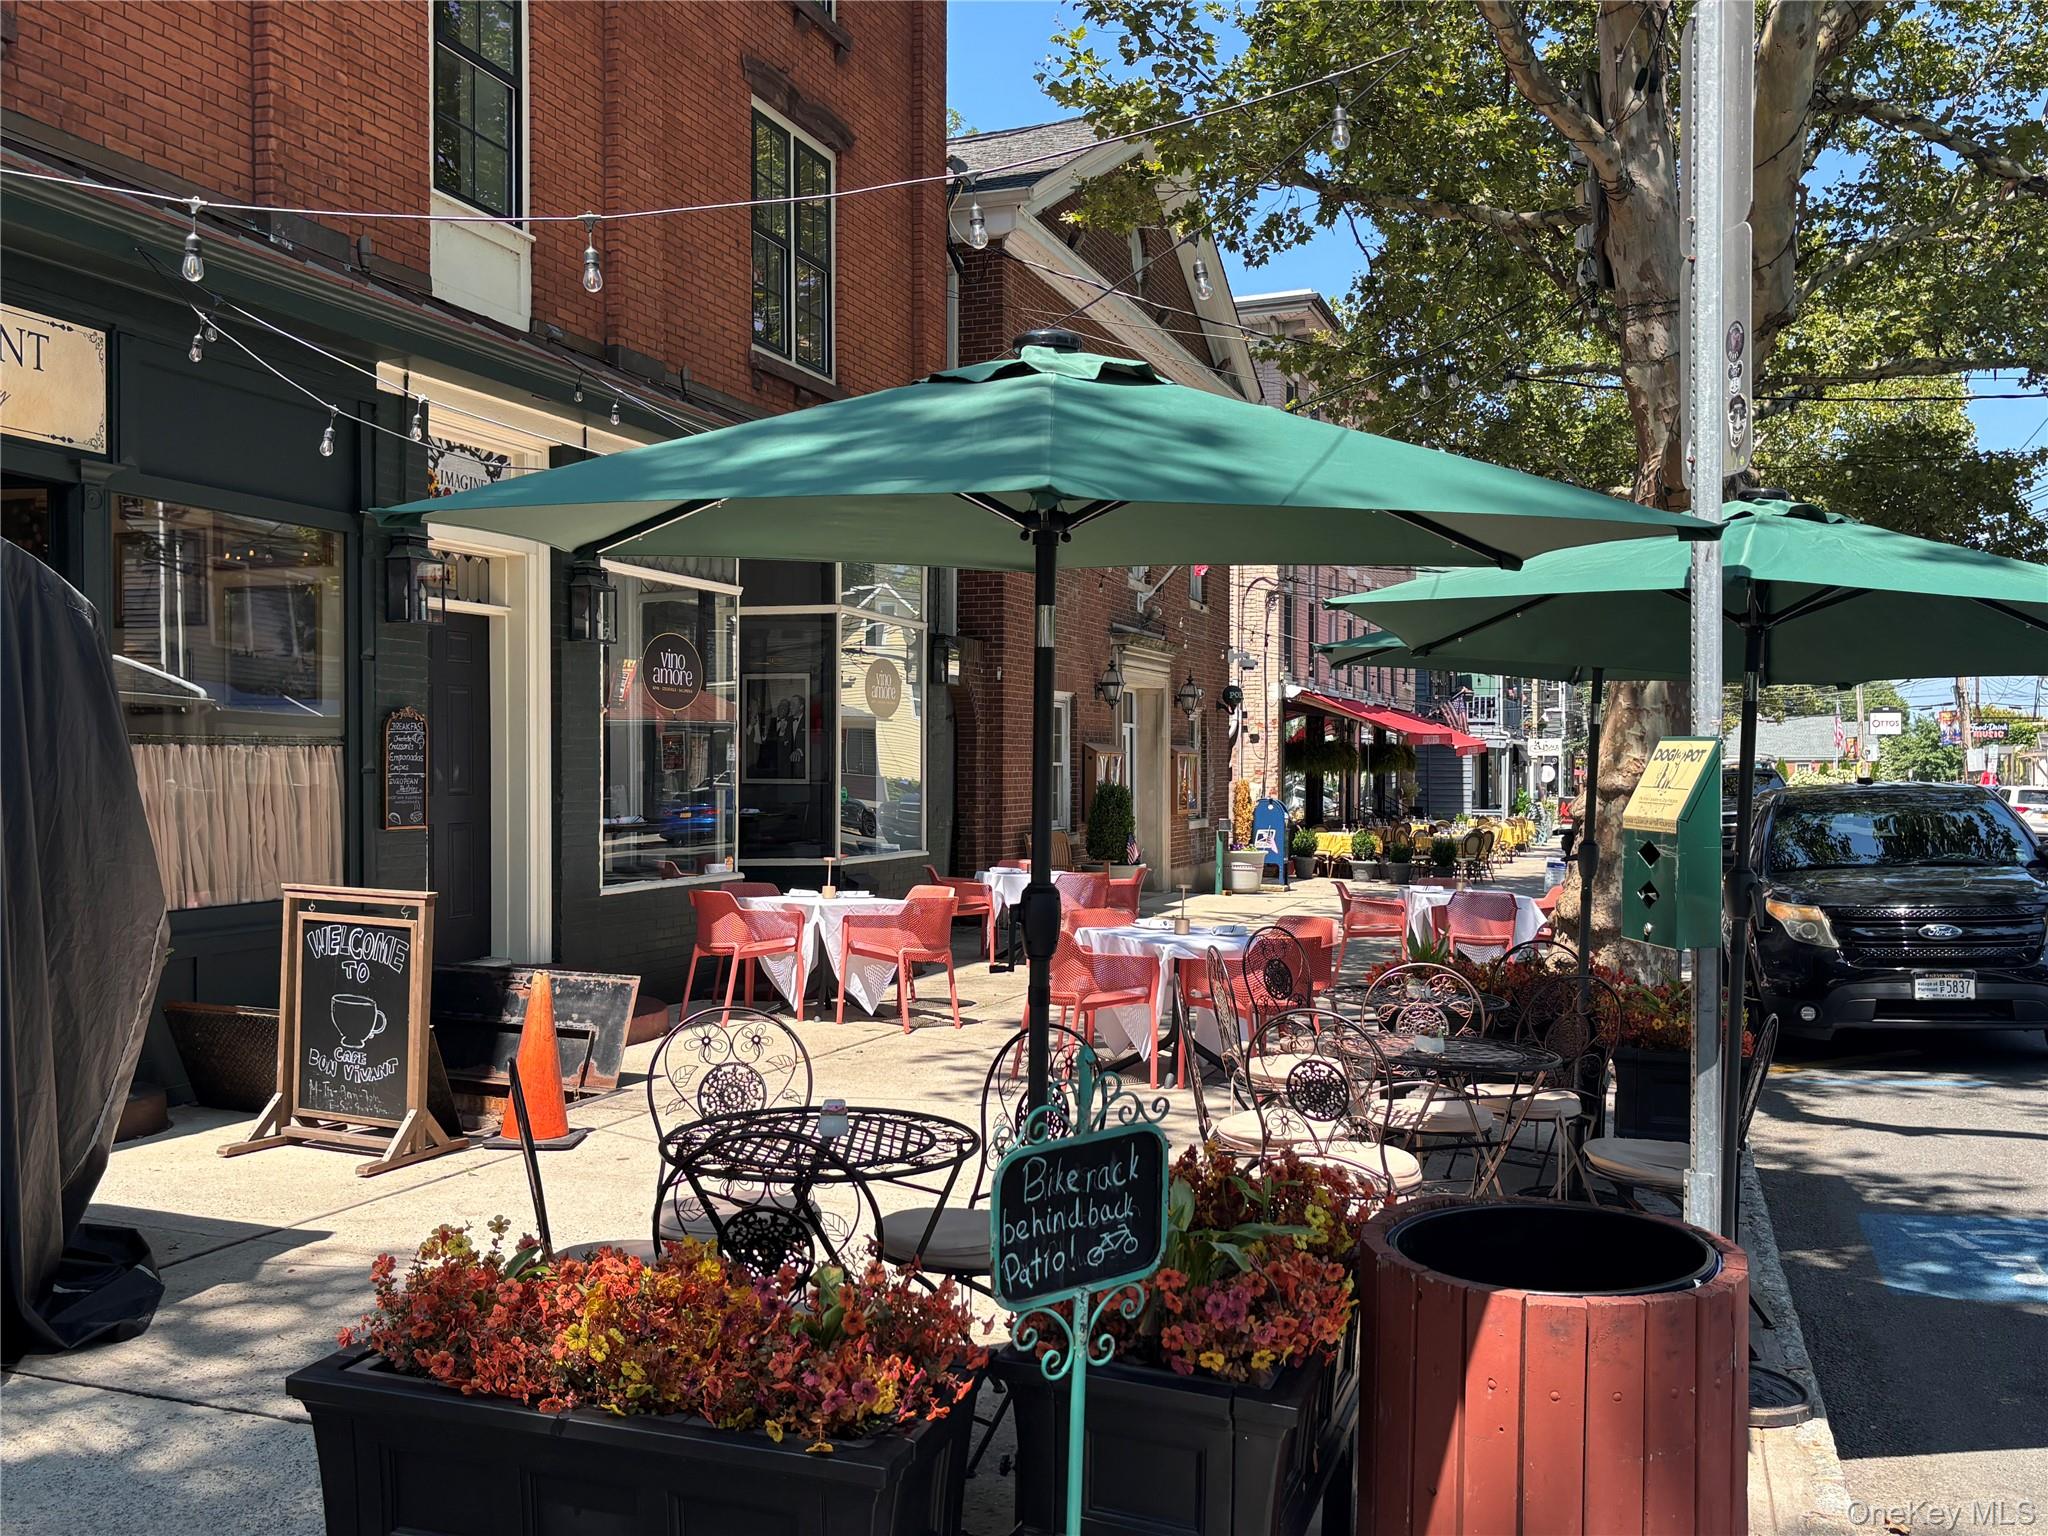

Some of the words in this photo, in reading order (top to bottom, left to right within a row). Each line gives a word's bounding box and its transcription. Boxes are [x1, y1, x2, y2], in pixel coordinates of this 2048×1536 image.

[660, 648, 686, 670] vino
[652, 666, 693, 687] amore
[876, 669, 892, 687] vino
[871, 685, 896, 700] amore
[1872, 719, 1900, 728] OTTOS
[1927, 926, 1952, 937] Ford
[306, 924, 410, 974] WELCOME
[341, 960, 371, 984] TO
[1946, 980, 1971, 994] 5837
[308, 1047, 338, 1078] BON
[333, 1046, 367, 1066] CAFE
[1022, 1156, 1081, 1205] Bike
[1086, 1141, 1140, 1193] rack
[1002, 1196, 1084, 1248] behind
[1087, 1191, 1134, 1226] back
[1000, 1233, 1077, 1295] Patio!
